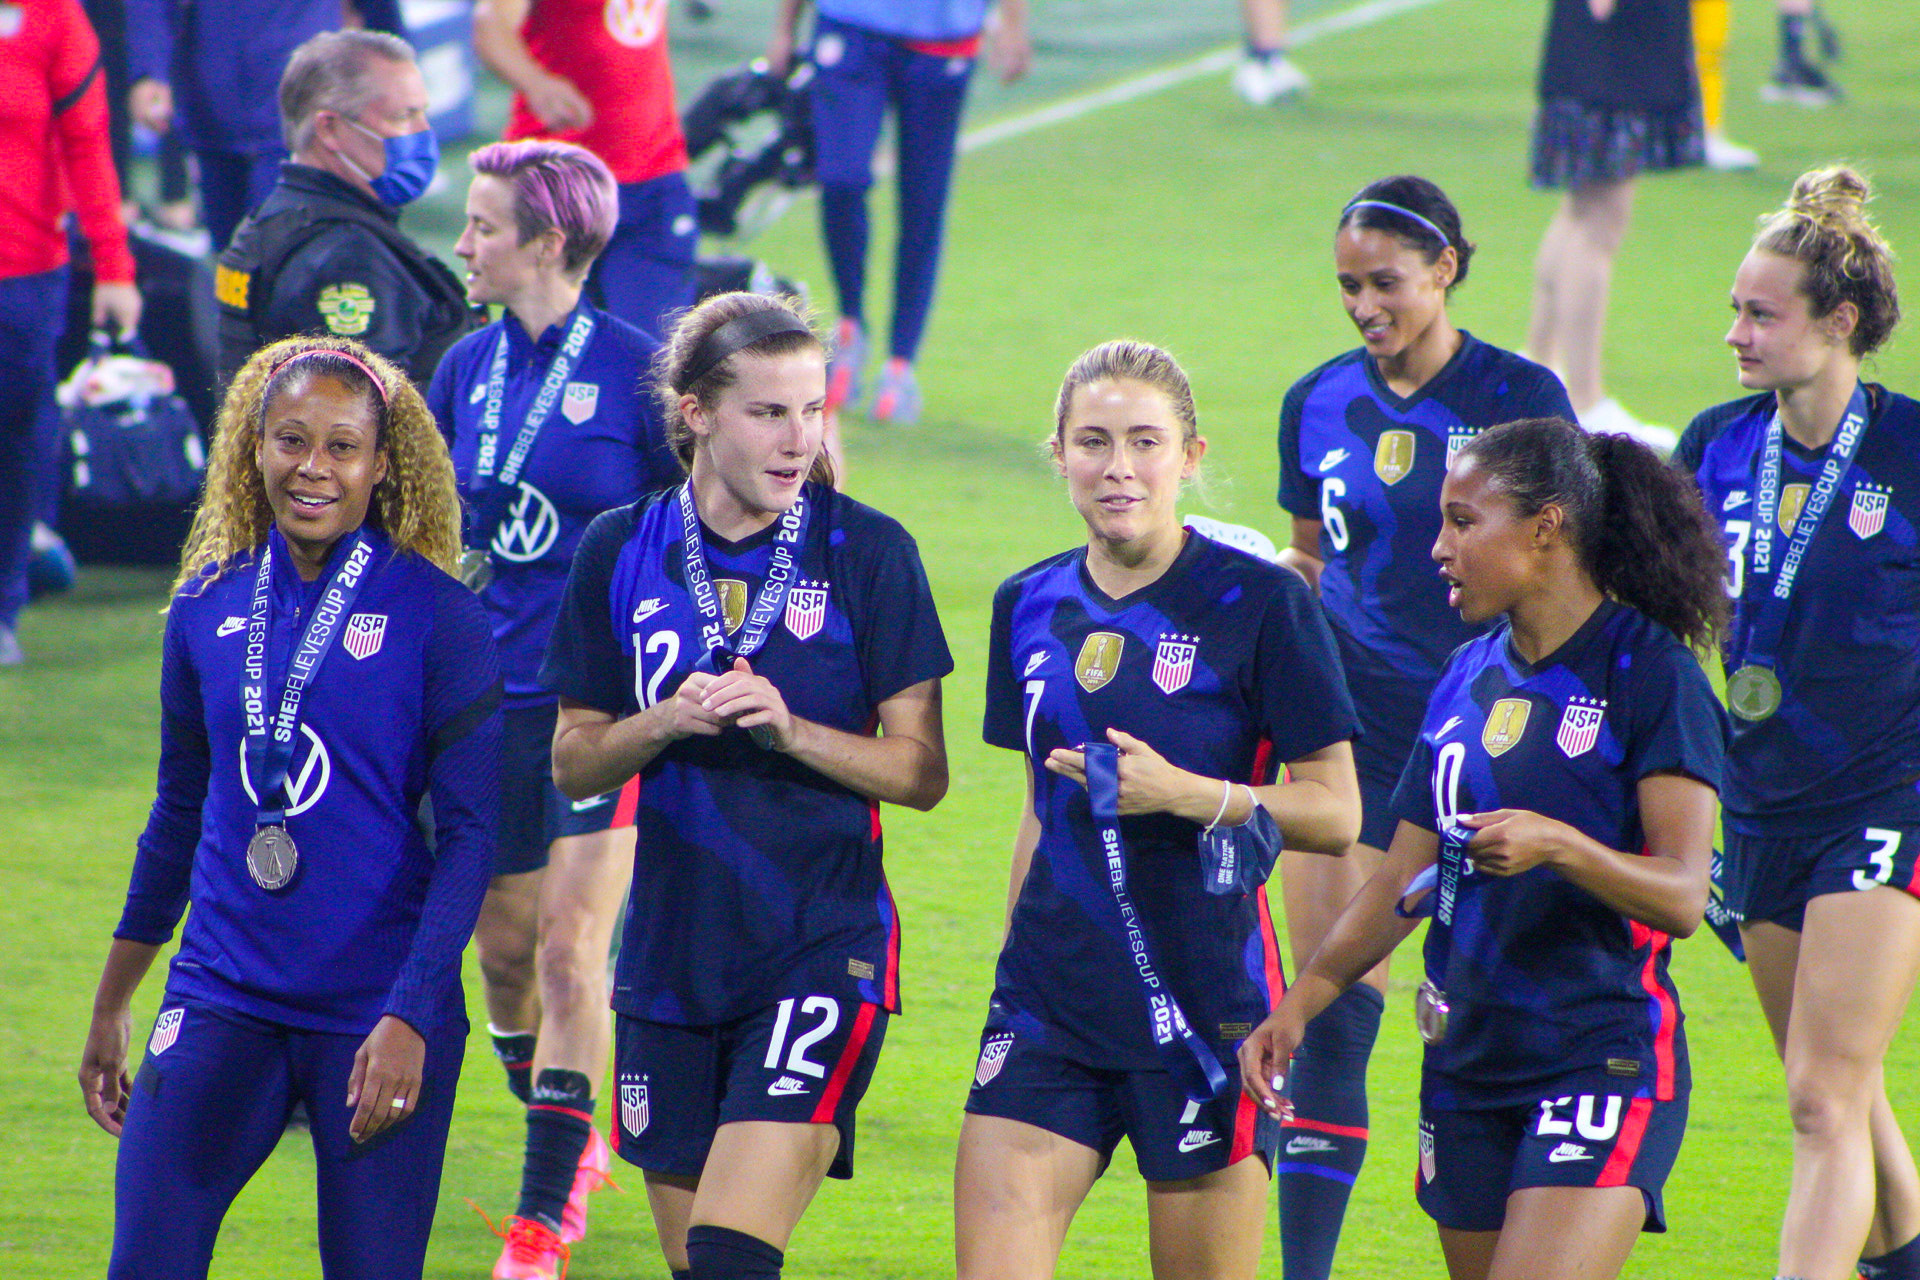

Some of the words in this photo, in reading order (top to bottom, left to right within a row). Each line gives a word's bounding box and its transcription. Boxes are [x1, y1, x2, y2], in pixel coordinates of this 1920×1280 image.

[499, 356, 571, 485] SHEBELIEVESCUP
[563, 314, 594, 358] 2021
[569, 385, 597, 402] USA
[477, 433, 497, 476] 2021
[1773, 458, 1841, 599] SHEBELIEVESCUP
[1832, 412, 1864, 458] 2021
[1855, 491, 1886, 512] USA
[1322, 477, 1349, 551] 6
[1721, 519, 1751, 598] 3
[1754, 528, 1772, 574] 2021
[638, 598, 661, 613] NIKE
[738, 546, 793, 656] BELIEVESCUP
[791, 591, 824, 615] USA
[223, 616, 247, 628] NIKE
[352, 615, 384, 633] USA
[274, 588, 348, 743] SHEBELIEVESCUP
[337, 540, 373, 588] 2021
[703, 621, 724, 650] 20
[1159, 644, 1194, 665] USA
[632, 630, 680, 711] 12
[1085, 668, 1105, 678] FIFA
[244, 686, 265, 735] 2021
[1025, 680, 1045, 758] 7
[1567, 708, 1598, 729] USA
[1852, 827, 1901, 891] 3
[1217, 867, 1226, 883] ONE
[1225, 868, 1233, 884] ONE
[1438, 826, 1468, 926] SHEBELIEVE
[1102, 828, 1160, 988] SHEBELIEVESCUP
[1150, 993, 1173, 1044] 2021
[158, 1012, 181, 1030] USA
[764, 996, 839, 1078] 12
[985, 1042, 1008, 1059] USA
[775, 1076, 804, 1090] NIKE
[622, 1087, 647, 1107] USA
[1185, 1131, 1213, 1143] NIKE
[1292, 1135, 1331, 1147] NIKE
[1556, 1142, 1586, 1156] NIKE
